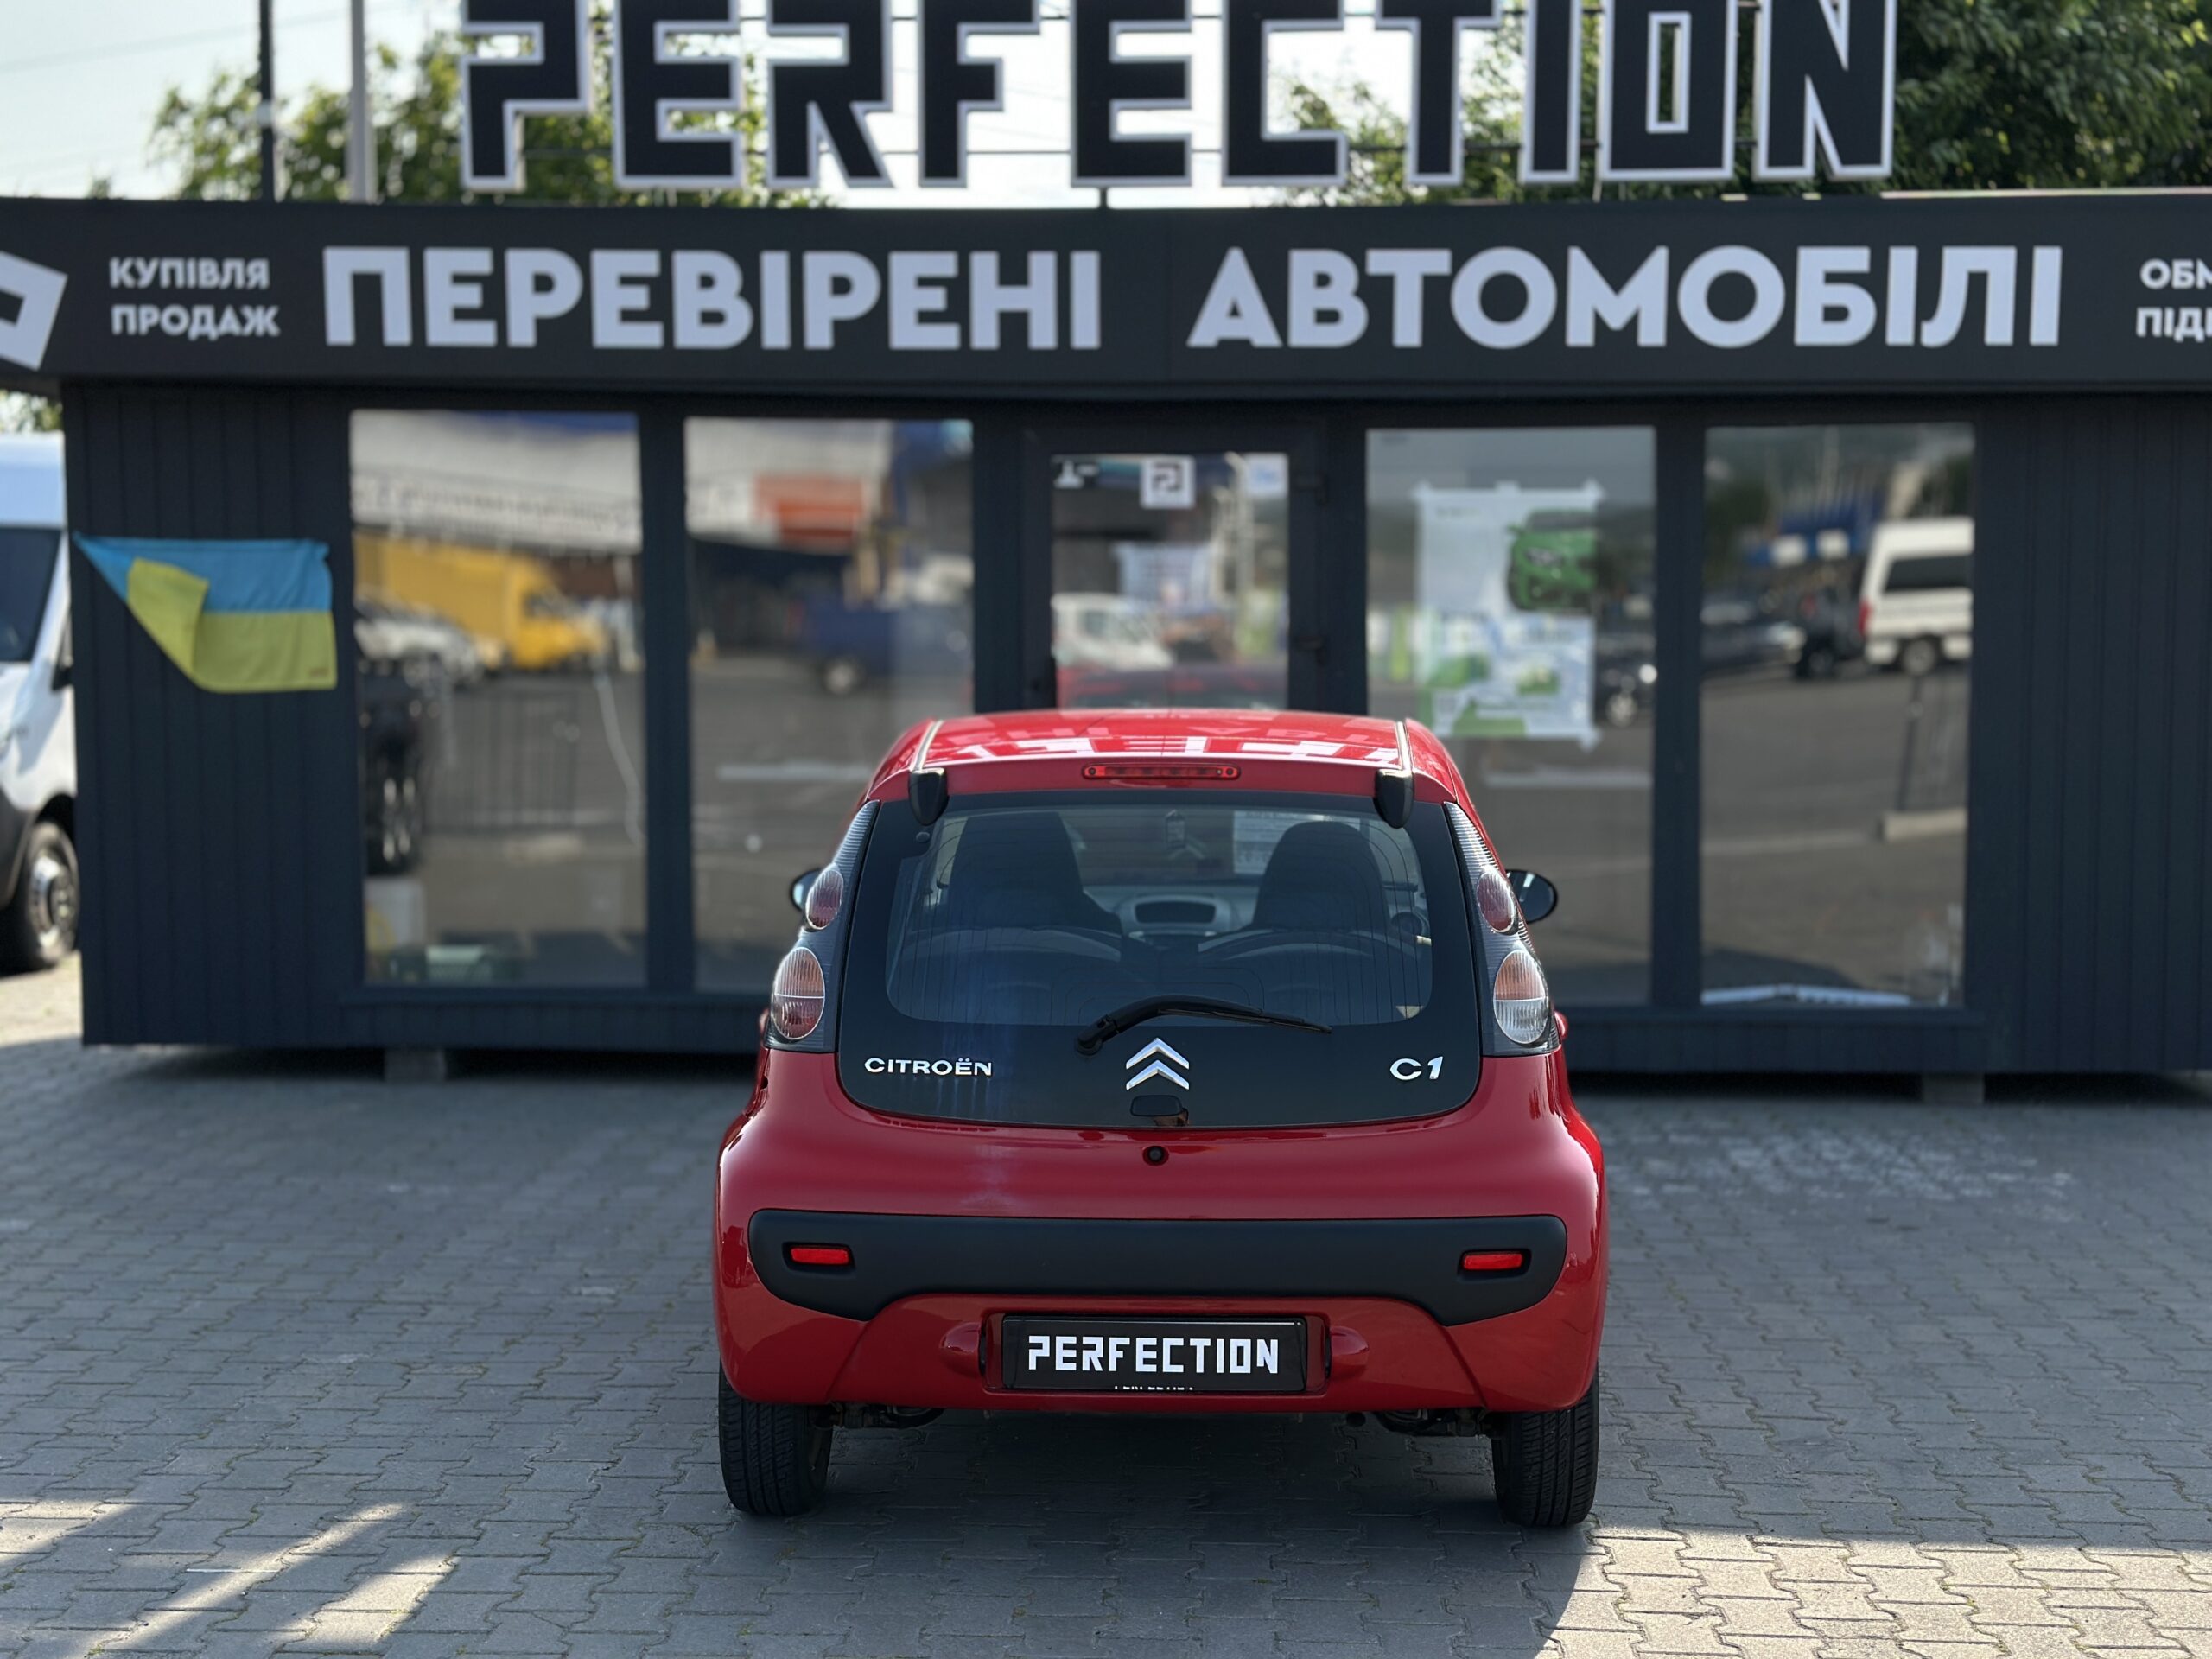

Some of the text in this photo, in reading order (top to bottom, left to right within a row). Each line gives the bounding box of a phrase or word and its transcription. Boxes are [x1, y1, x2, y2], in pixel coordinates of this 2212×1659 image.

[461, 0, 1897, 191] PERFECTION
[110, 257, 269, 289] КУПІВЛЯ
[323, 245, 2063, 350] ПЕРЕВІРЕНІ АВТОМОБІЛІ
[111, 304, 279, 340] ПРОДАЖ
[864, 1056, 993, 1077] CITROËN
[1389, 1056, 1444, 1081] C1
[1028, 1335, 1279, 1374] PERFECTION
